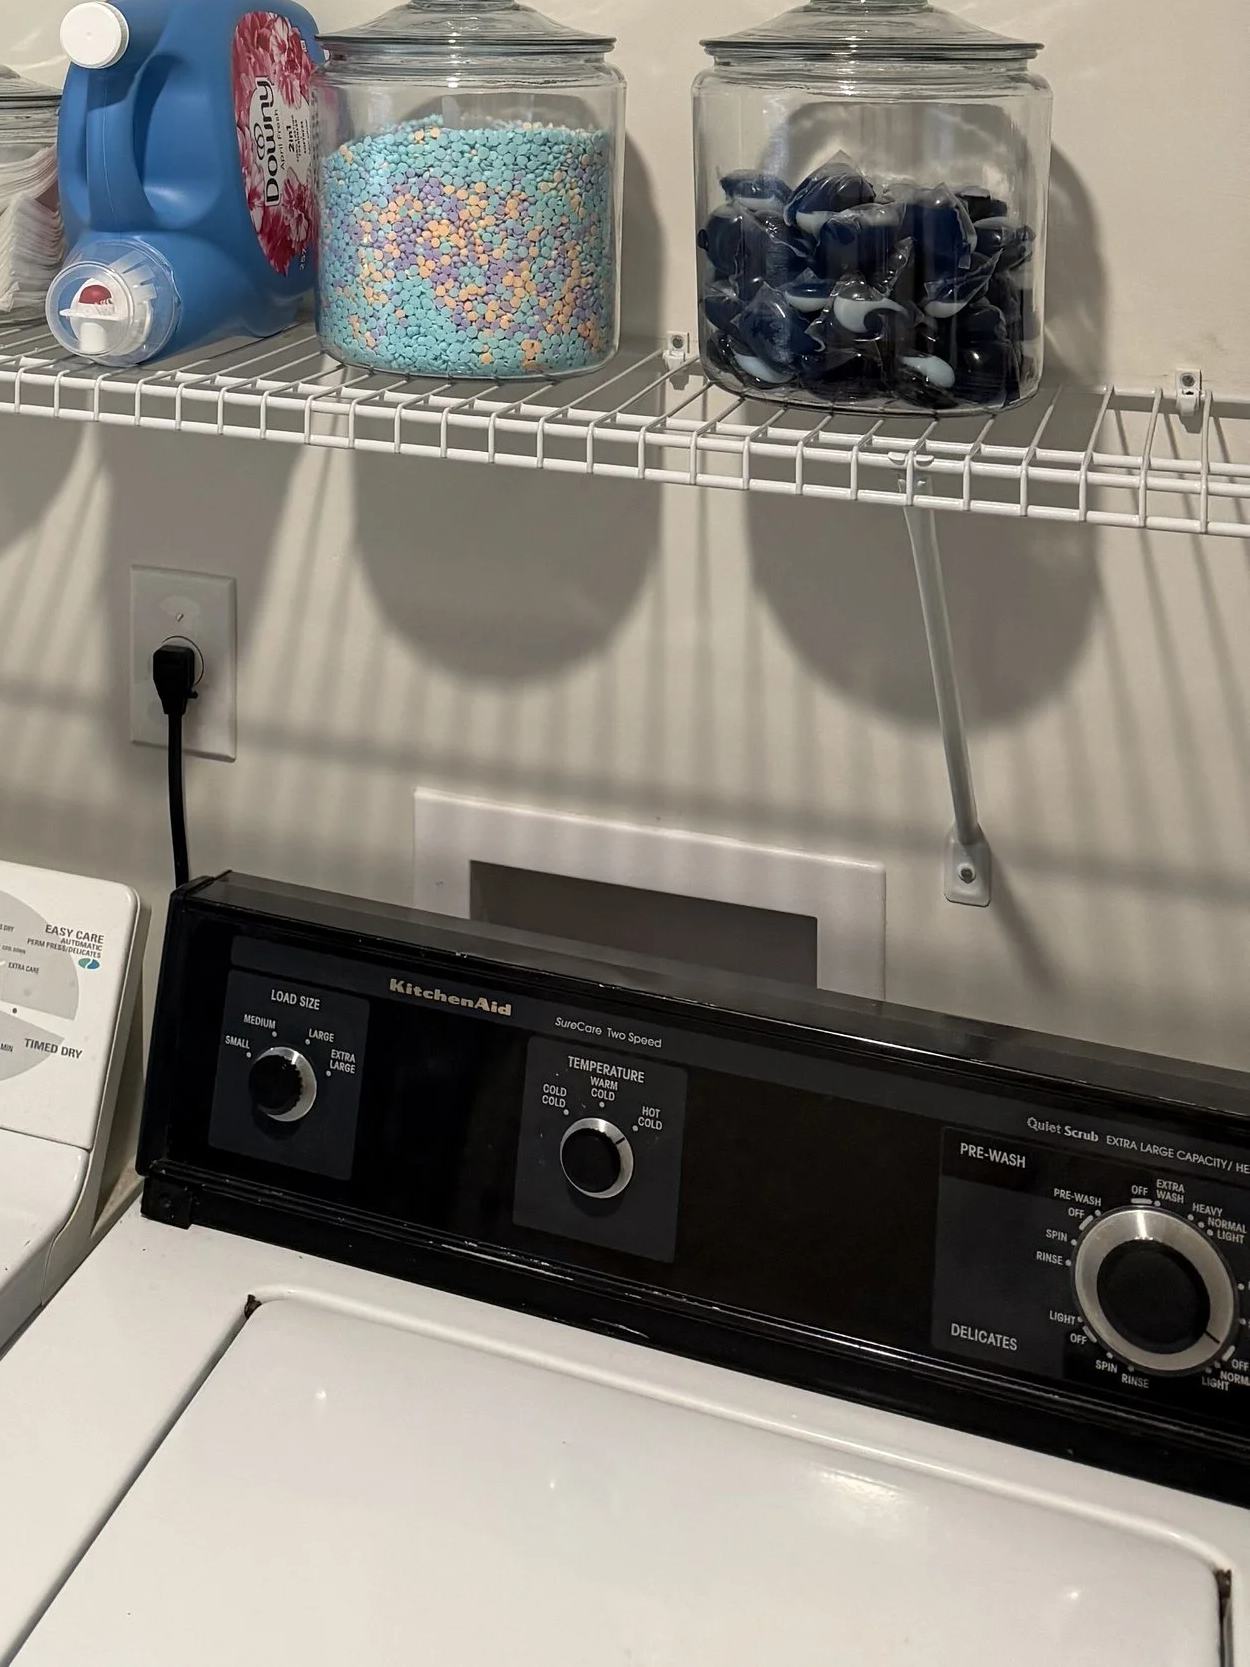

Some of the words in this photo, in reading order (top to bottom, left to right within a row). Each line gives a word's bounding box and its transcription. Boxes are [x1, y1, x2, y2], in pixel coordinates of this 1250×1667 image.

[257, 81, 279, 201] Downy
[3, 924, 14, 932] DRY
[45, 924, 73, 937] EASY
[75, 930, 105, 944] CARE
[27, 938, 45, 948] PERM
[60, 937, 103, 952] AUTOMATIC
[8, 961, 25, 971] EXTRA
[25, 964, 40, 974] CARE
[270, 989, 297, 1005] LOAD
[299, 995, 321, 1011] SIZE
[388, 978, 512, 1017] KitchenAid
[243, 1013, 276, 1030] MEDIUM
[224, 1034, 250, 1050] SMALL
[308, 1028, 335, 1043] LARGE
[554, 1016, 603, 1036] SureCare
[606, 1027, 626, 1041] Two
[628, 1032, 662, 1049] Speed
[0, 1043, 14, 1053] MIN
[24, 1038, 59, 1054] TIMED
[60, 1046, 83, 1059] DRY
[330, 1049, 356, 1064] EXTRA
[329, 1059, 356, 1074] LARGE
[567, 1055, 646, 1084] TEMPERATURE
[542, 1083, 567, 1098] COLD
[590, 1075, 619, 1091] WARM
[541, 1094, 566, 1108] COLD
[590, 1087, 616, 1102] COLD
[641, 1104, 661, 1119] HOT
[637, 1116, 663, 1131] COLD
[1026, 1117, 1062, 1135] Quiet
[1064, 1125, 1099, 1143] Scrub
[1105, 1135, 1137, 1151] EXTRA
[1139, 1141, 1174, 1159] LARGE
[960, 1142, 1026, 1169] PRE-WASH
[1053, 1187, 1102, 1207] PRE-WASH
[1131, 1184, 1149, 1197] OFF
[1156, 1179, 1185, 1194] EXTRA
[1156, 1189, 1185, 1204] WASH
[1068, 1207, 1085, 1219] OFF
[1192, 1202, 1223, 1218] HEAVY
[1207, 1217, 1248, 1234] NORMAL
[1045, 1229, 1068, 1243] SPIN
[1216, 1229, 1245, 1245] LIGHT
[1036, 1250, 1064, 1266] RINSE
[1049, 1310, 1076, 1325] LIGHT
[950, 1323, 1018, 1351] DELICATES
[1069, 1333, 1087, 1346] OFF
[1095, 1359, 1118, 1374] SPIN
[1231, 1358, 1249, 1371] OFF
[1121, 1373, 1150, 1389] RINSE
[1201, 1376, 1230, 1392] LIGHT
